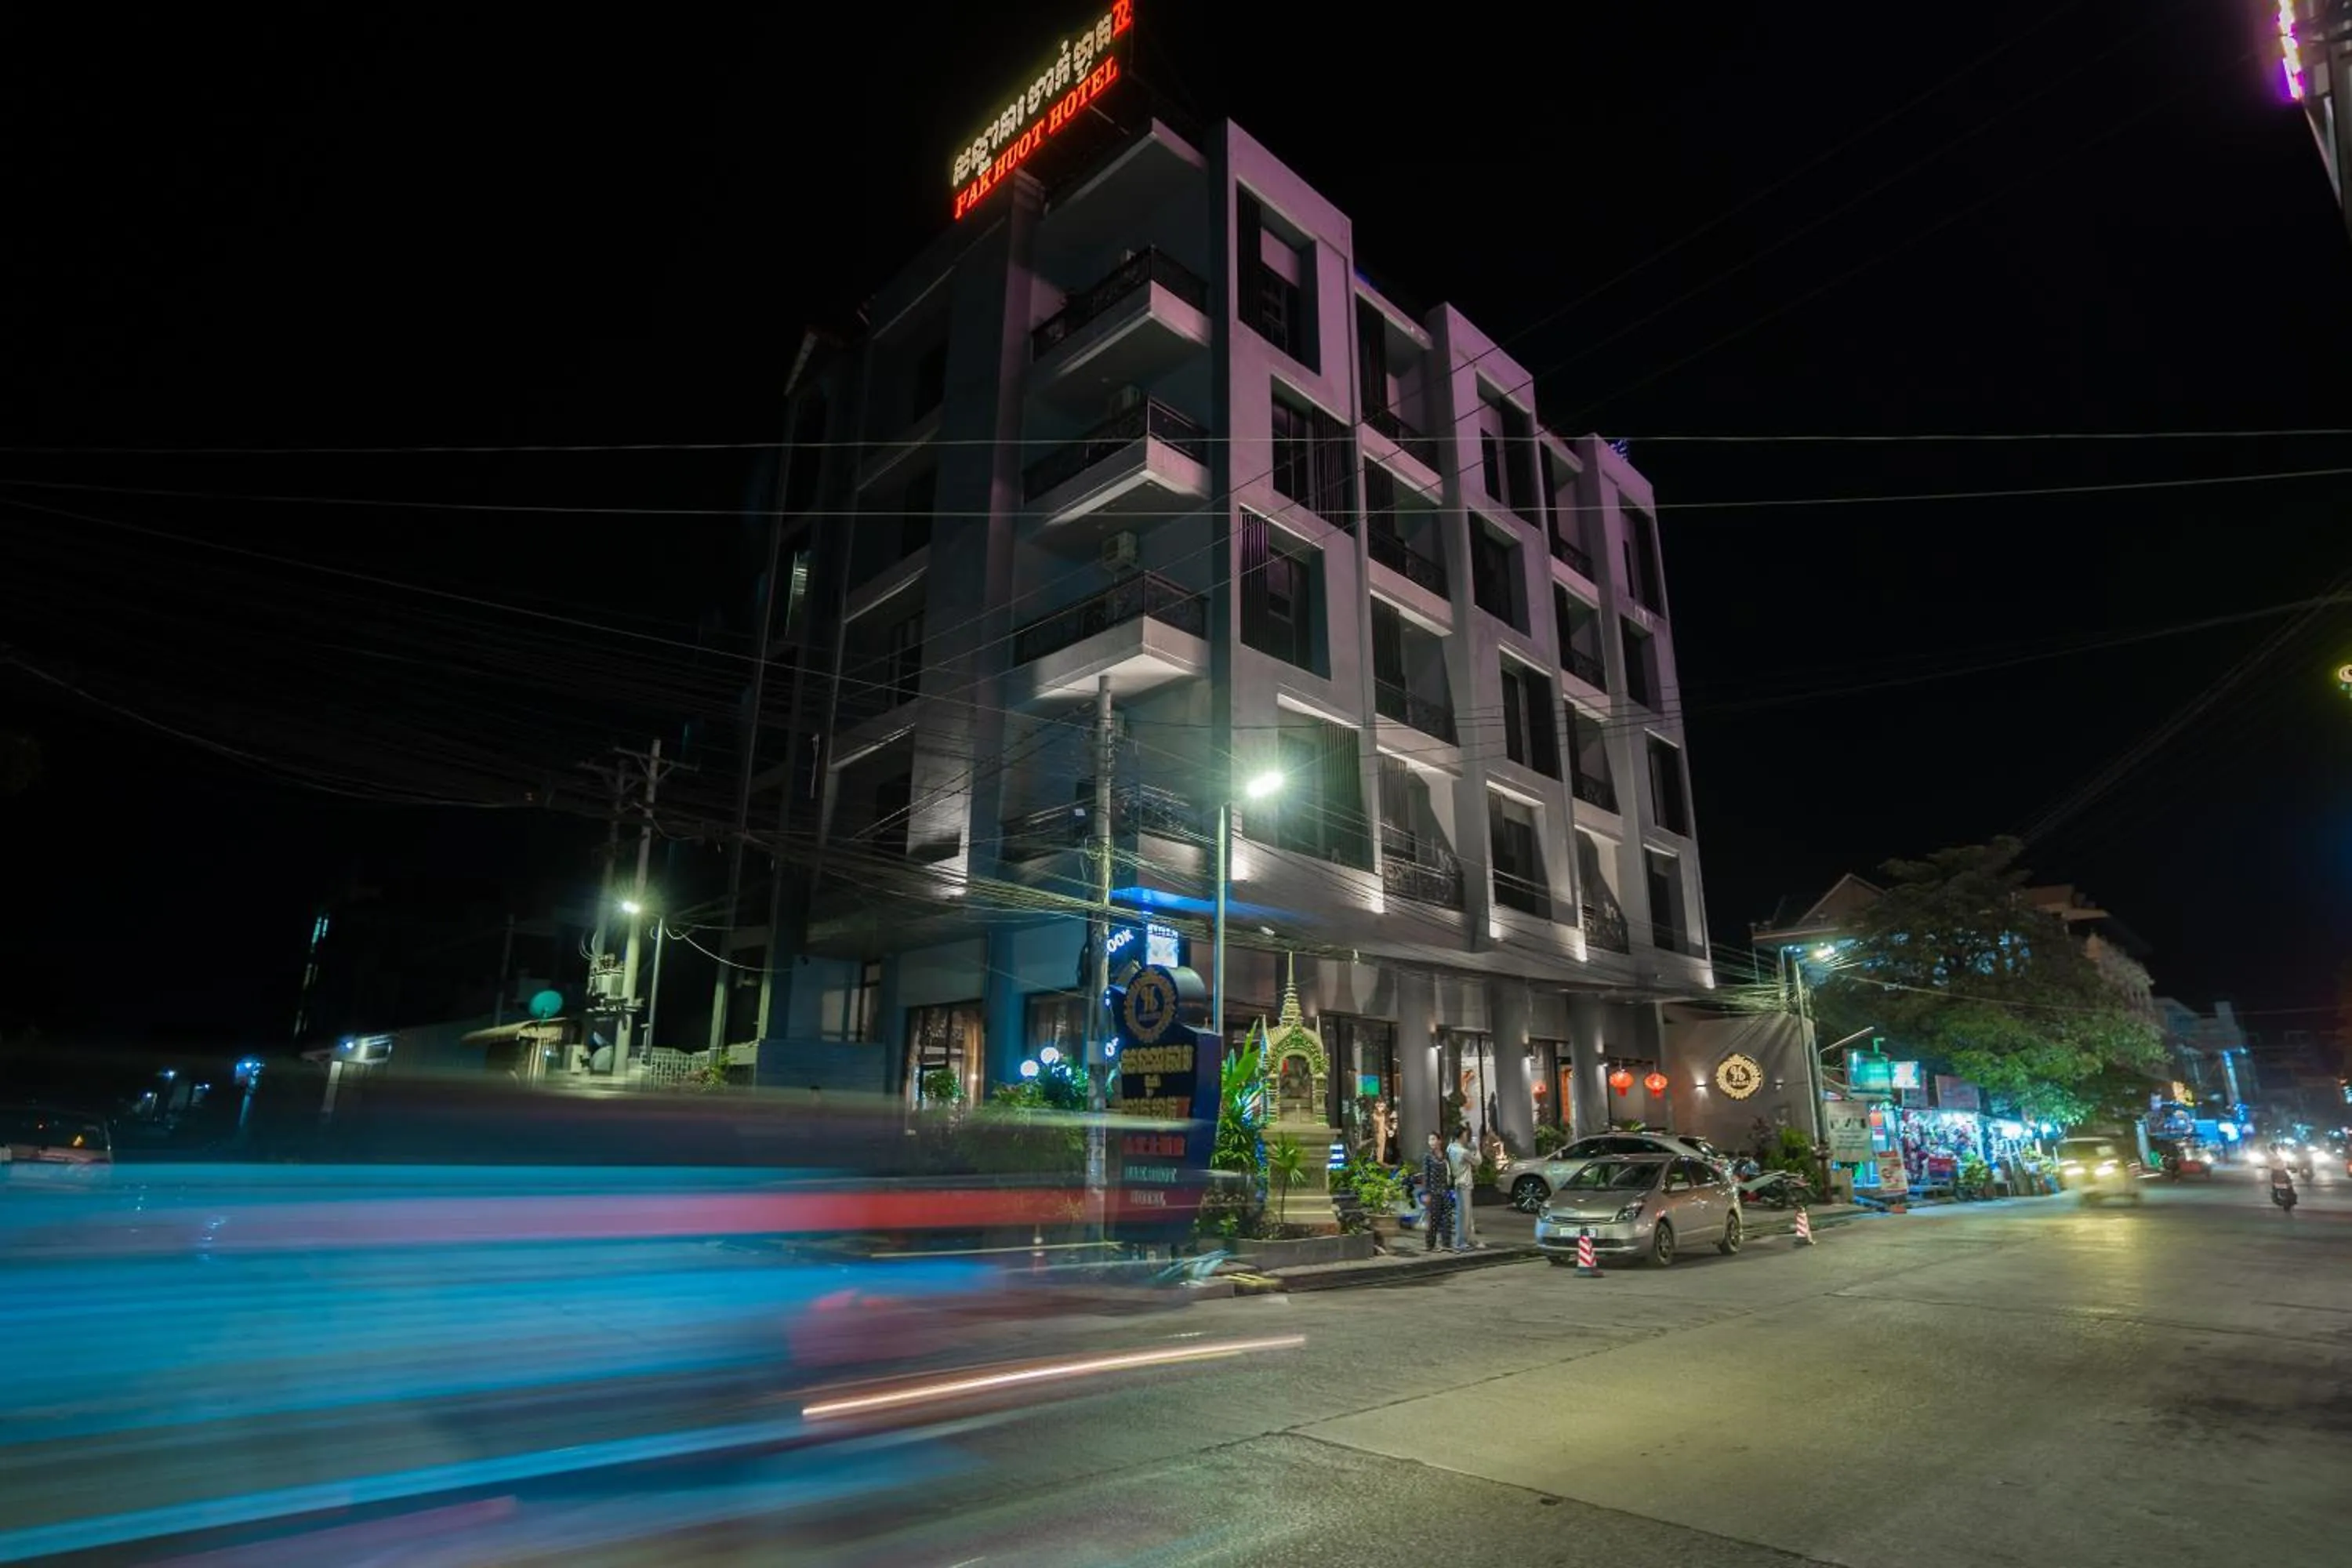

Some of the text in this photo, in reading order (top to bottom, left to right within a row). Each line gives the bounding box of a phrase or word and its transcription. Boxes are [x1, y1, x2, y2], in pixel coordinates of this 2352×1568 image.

[954, 56, 1118, 220] PAK HUOT HOTEL
[1106, 928, 1134, 953] OOK
